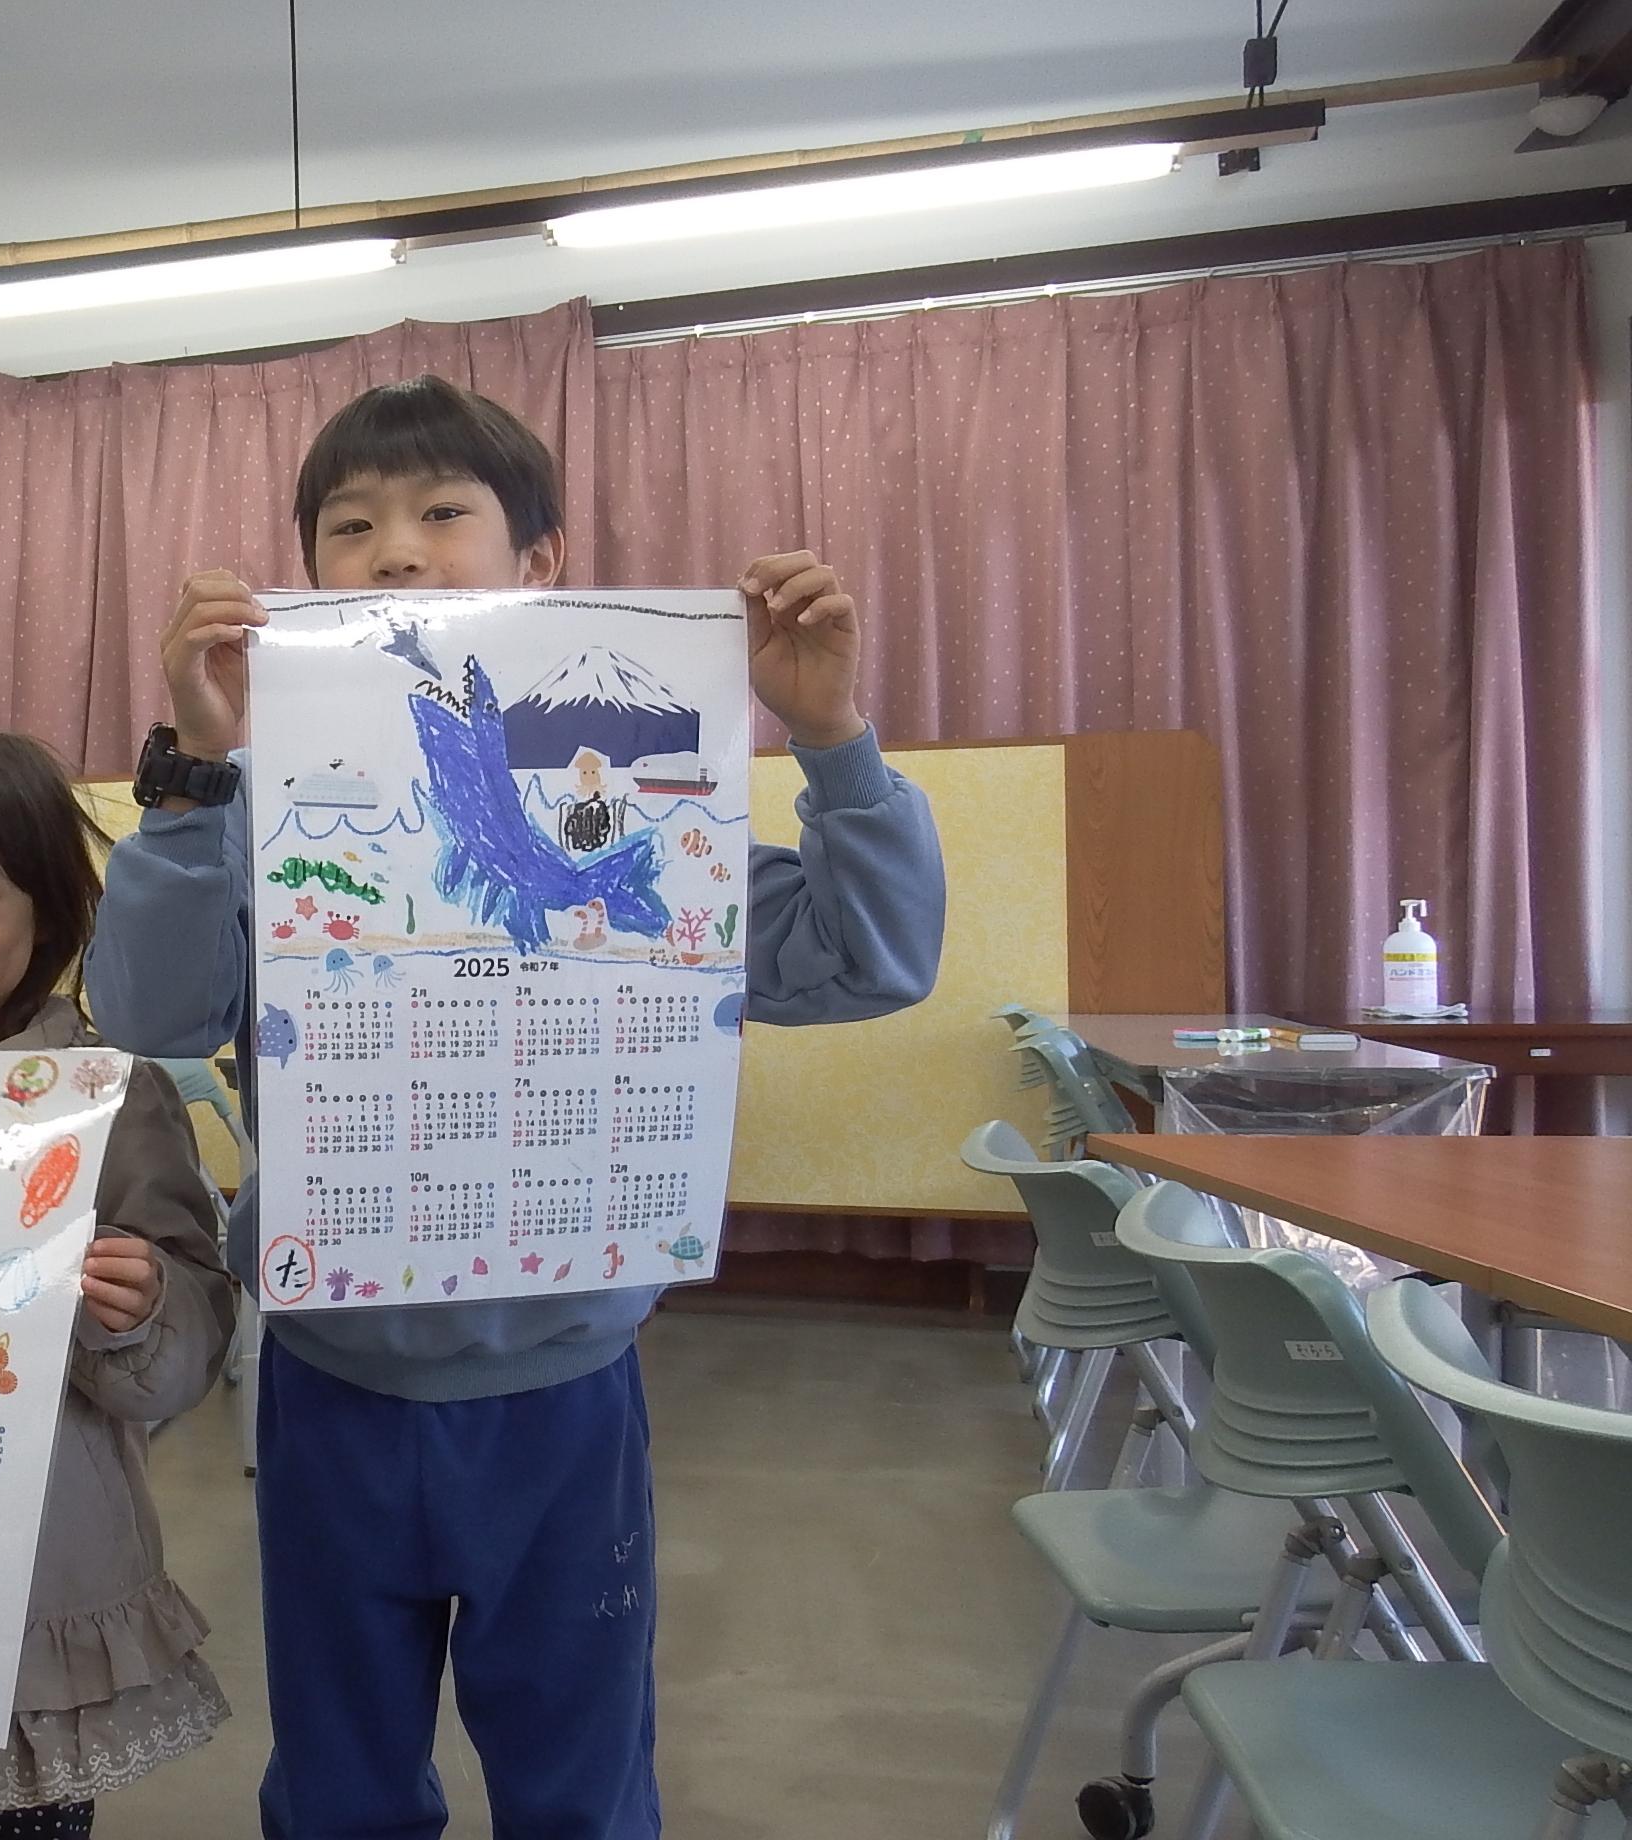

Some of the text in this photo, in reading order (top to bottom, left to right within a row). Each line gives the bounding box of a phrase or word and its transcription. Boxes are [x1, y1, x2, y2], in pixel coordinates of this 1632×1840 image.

[453, 958, 510, 977] 2025
[306, 990, 320, 999] 1月
[411, 988, 427, 998] 2月
[515, 986, 532, 996] 3月
[617, 985, 633, 994] 4月
[514, 1078, 530, 1088] 7月
[615, 1075, 630, 1084] 8月
[306, 1082, 322, 1093] 5月
[411, 1080, 427, 1090] 6月
[512, 1168, 531, 1178] 11月
[610, 1164, 628, 1174] 12月
[306, 1175, 322, 1185] 9月
[410, 1172, 429, 1182] 10月
[275, 1248, 309, 1288] た
